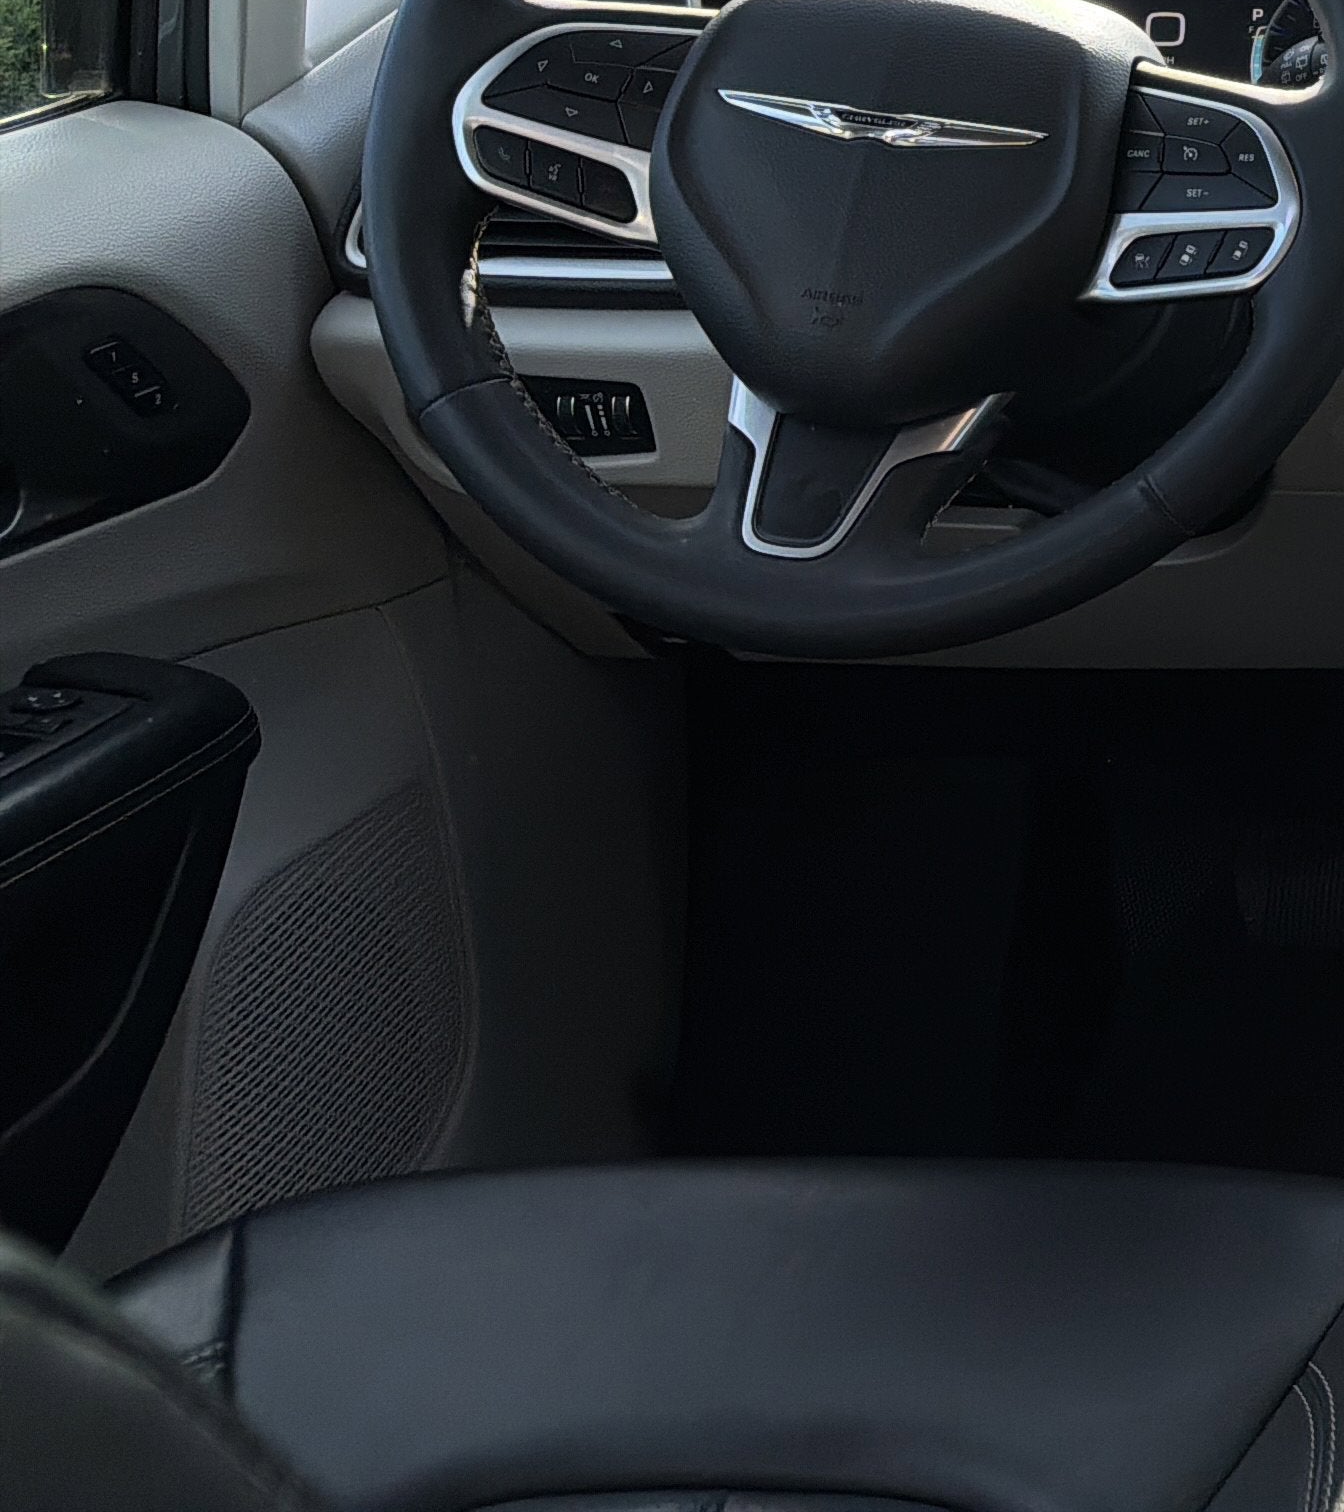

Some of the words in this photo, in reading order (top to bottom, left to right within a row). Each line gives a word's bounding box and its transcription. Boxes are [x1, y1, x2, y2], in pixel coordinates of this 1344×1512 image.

[1252, 8, 1264, 22] P
[585, 73, 599, 84] OK
[1127, 149, 1150, 158] CANC
[1238, 153, 1254, 162] RES
